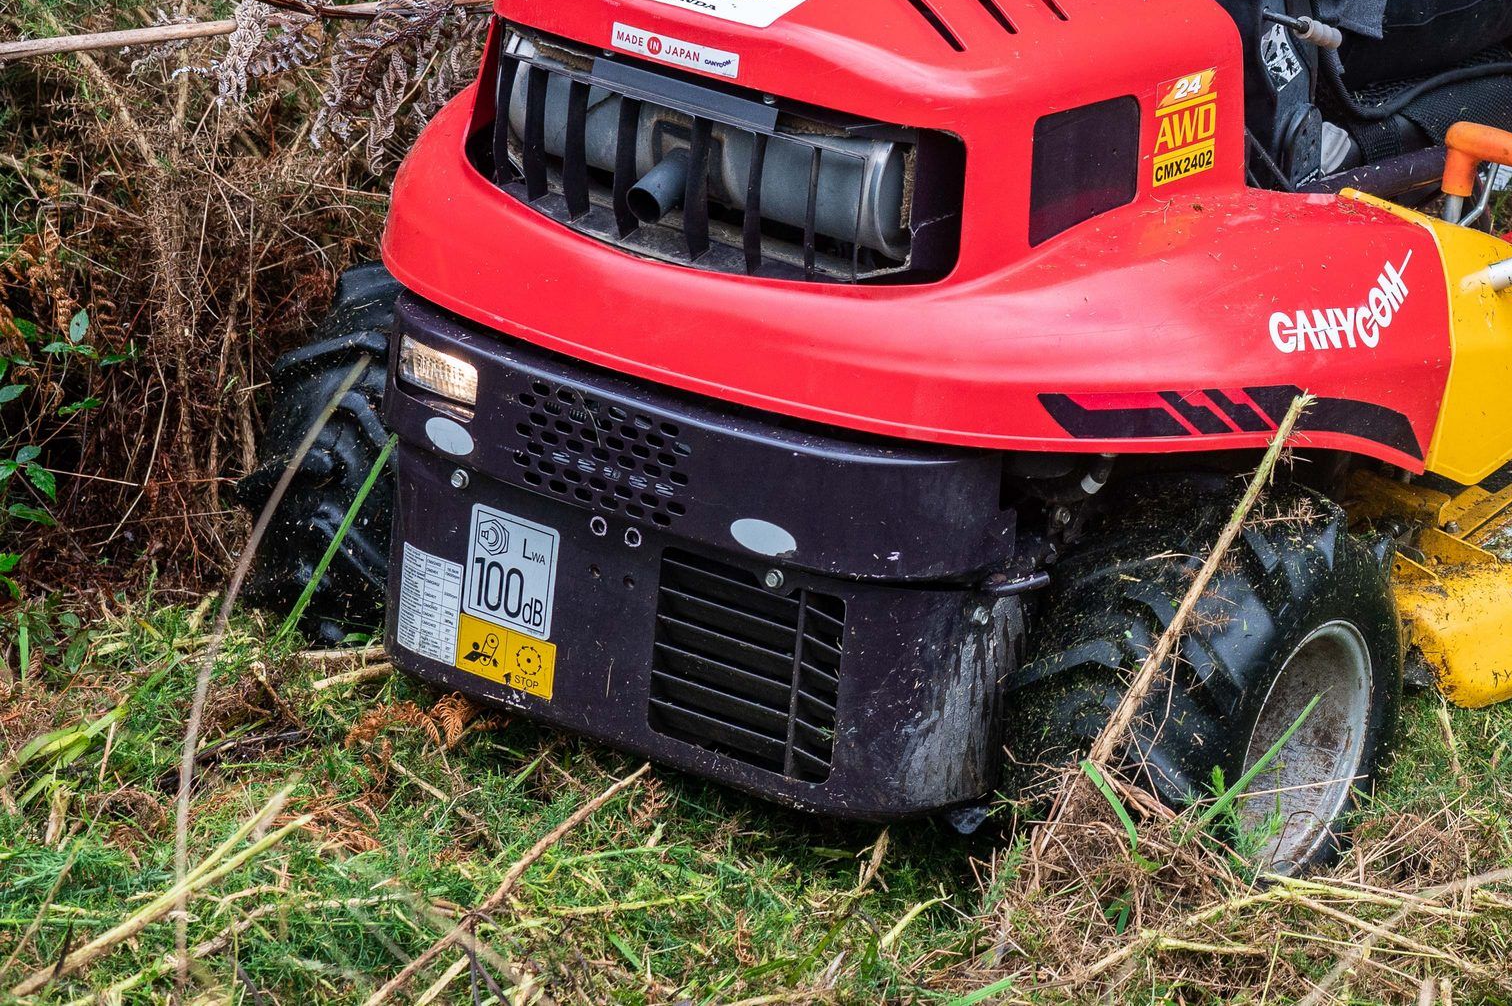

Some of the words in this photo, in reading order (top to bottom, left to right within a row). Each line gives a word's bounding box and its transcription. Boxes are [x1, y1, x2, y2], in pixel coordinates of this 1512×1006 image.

[616, 30, 644, 47] MADE
[648, 39, 660, 52] IN
[664, 45, 700, 63] JAPAN
[1173, 73, 1202, 100] 24
[1153, 102, 1217, 155] AWD
[1154, 149, 1213, 183] CMX2402
[1268, 248, 1413, 354] CANYCOM
[513, 674, 540, 689] STOP
